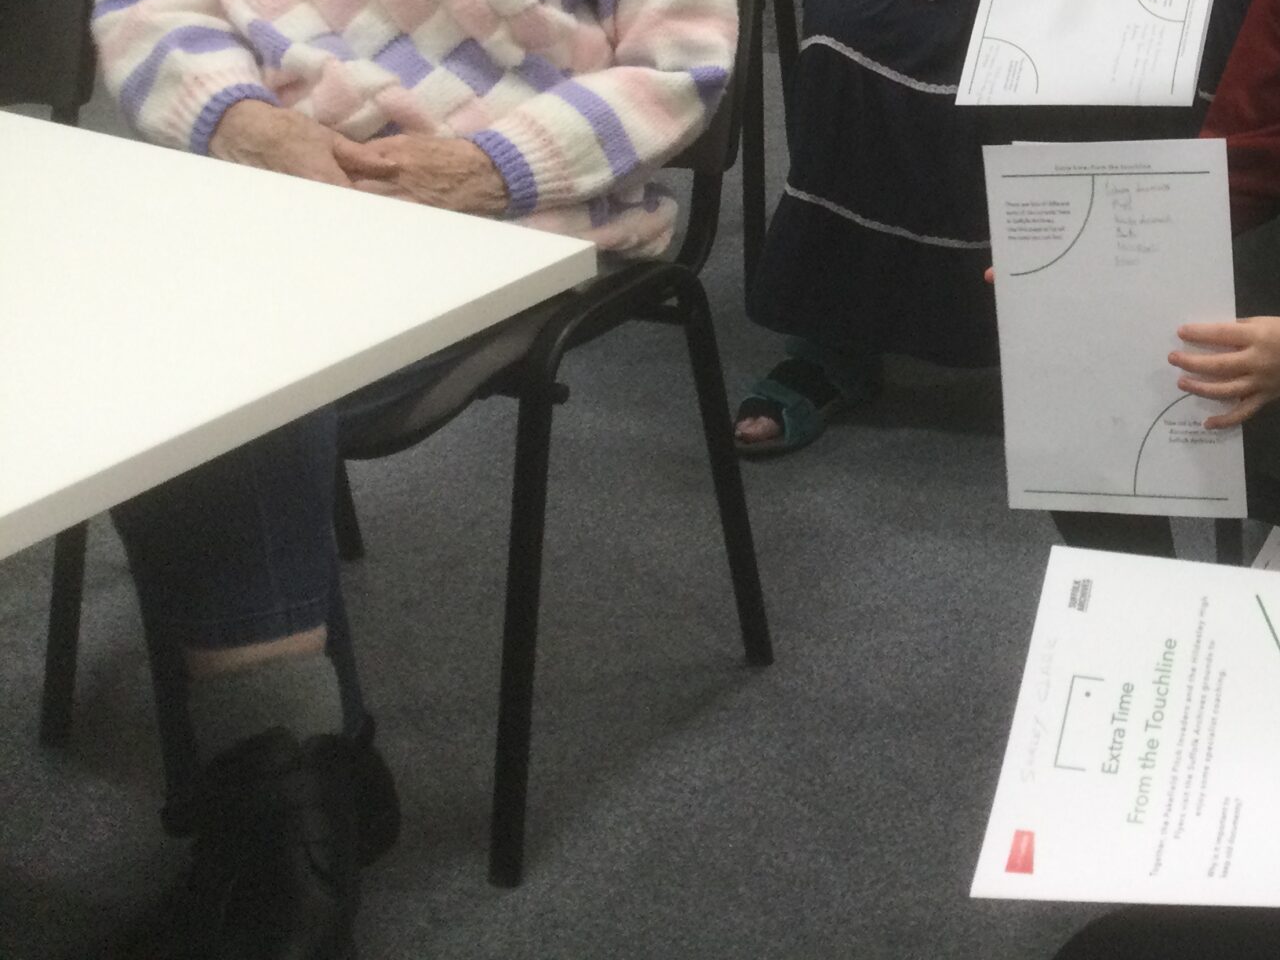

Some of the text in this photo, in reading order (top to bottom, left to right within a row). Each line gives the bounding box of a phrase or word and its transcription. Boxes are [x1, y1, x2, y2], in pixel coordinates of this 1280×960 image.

[1207, 639, 1215, 650] to
[1188, 667, 1198, 682] the
[1185, 684, 1194, 702] and
[1178, 705, 1192, 746] Invaders
[1194, 694, 1207, 735] Archives
[1101, 681, 1135, 776] Extra Time
[1126, 638, 1177, 825] From the Touchline
[1187, 739, 1200, 771] Suffolk
[1185, 774, 1193, 789] the
[1160, 820, 1170, 835] the
